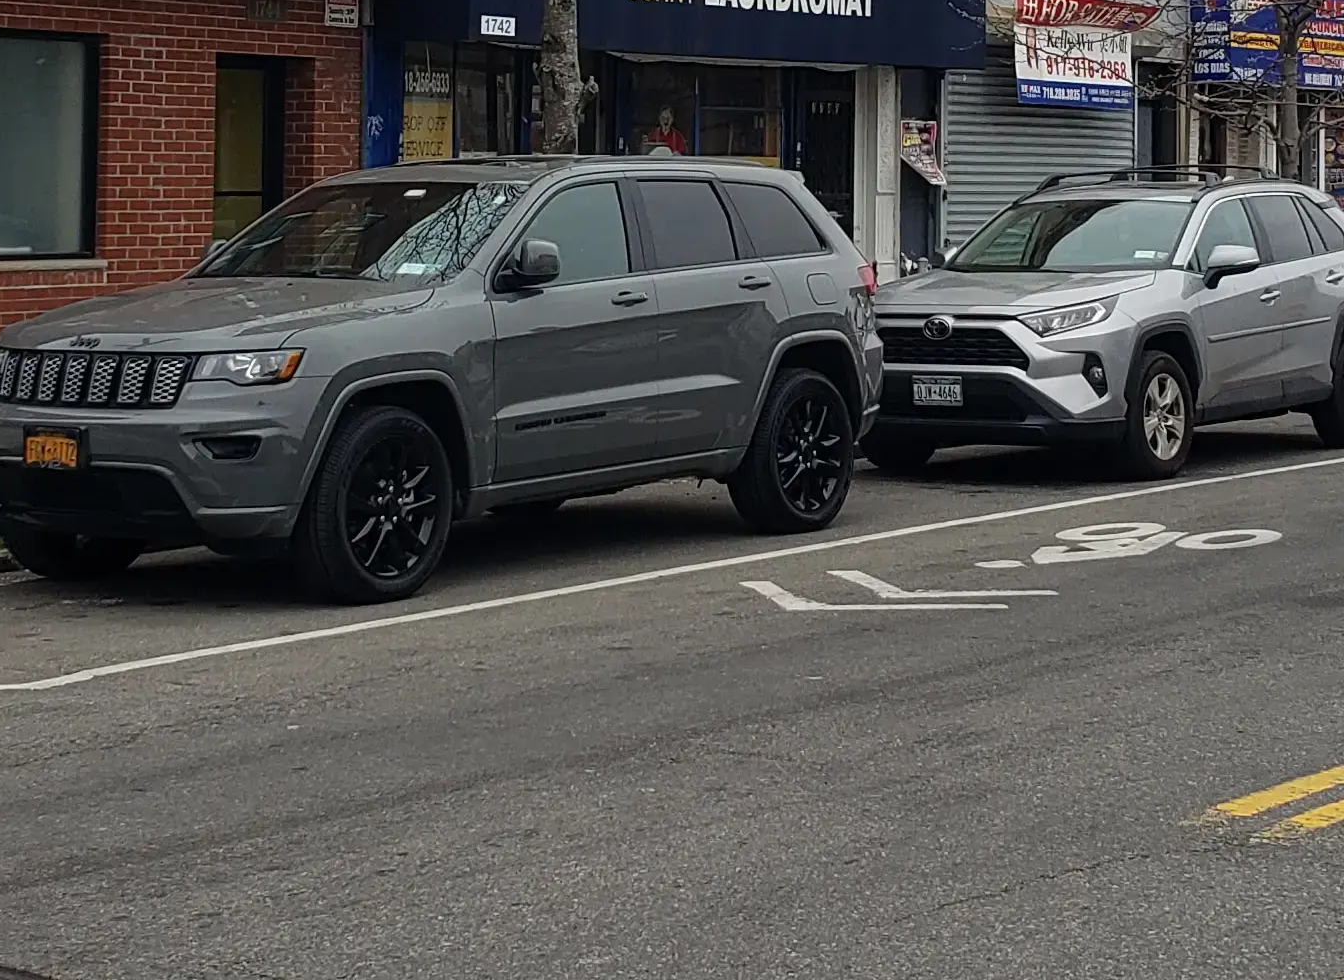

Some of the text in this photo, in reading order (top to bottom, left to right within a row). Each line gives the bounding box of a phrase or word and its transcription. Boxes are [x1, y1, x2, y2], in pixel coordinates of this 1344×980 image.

[484, 18, 511, 34] 1742
[1046, 29, 1094, 52] Kelly Wu
[1194, 62, 1209, 74] LOS
[1210, 62, 1231, 74] DIAS
[403, 116, 421, 131] ROP
[403, 141, 443, 156] ERVICE
[69, 334, 101, 349] Jeep
